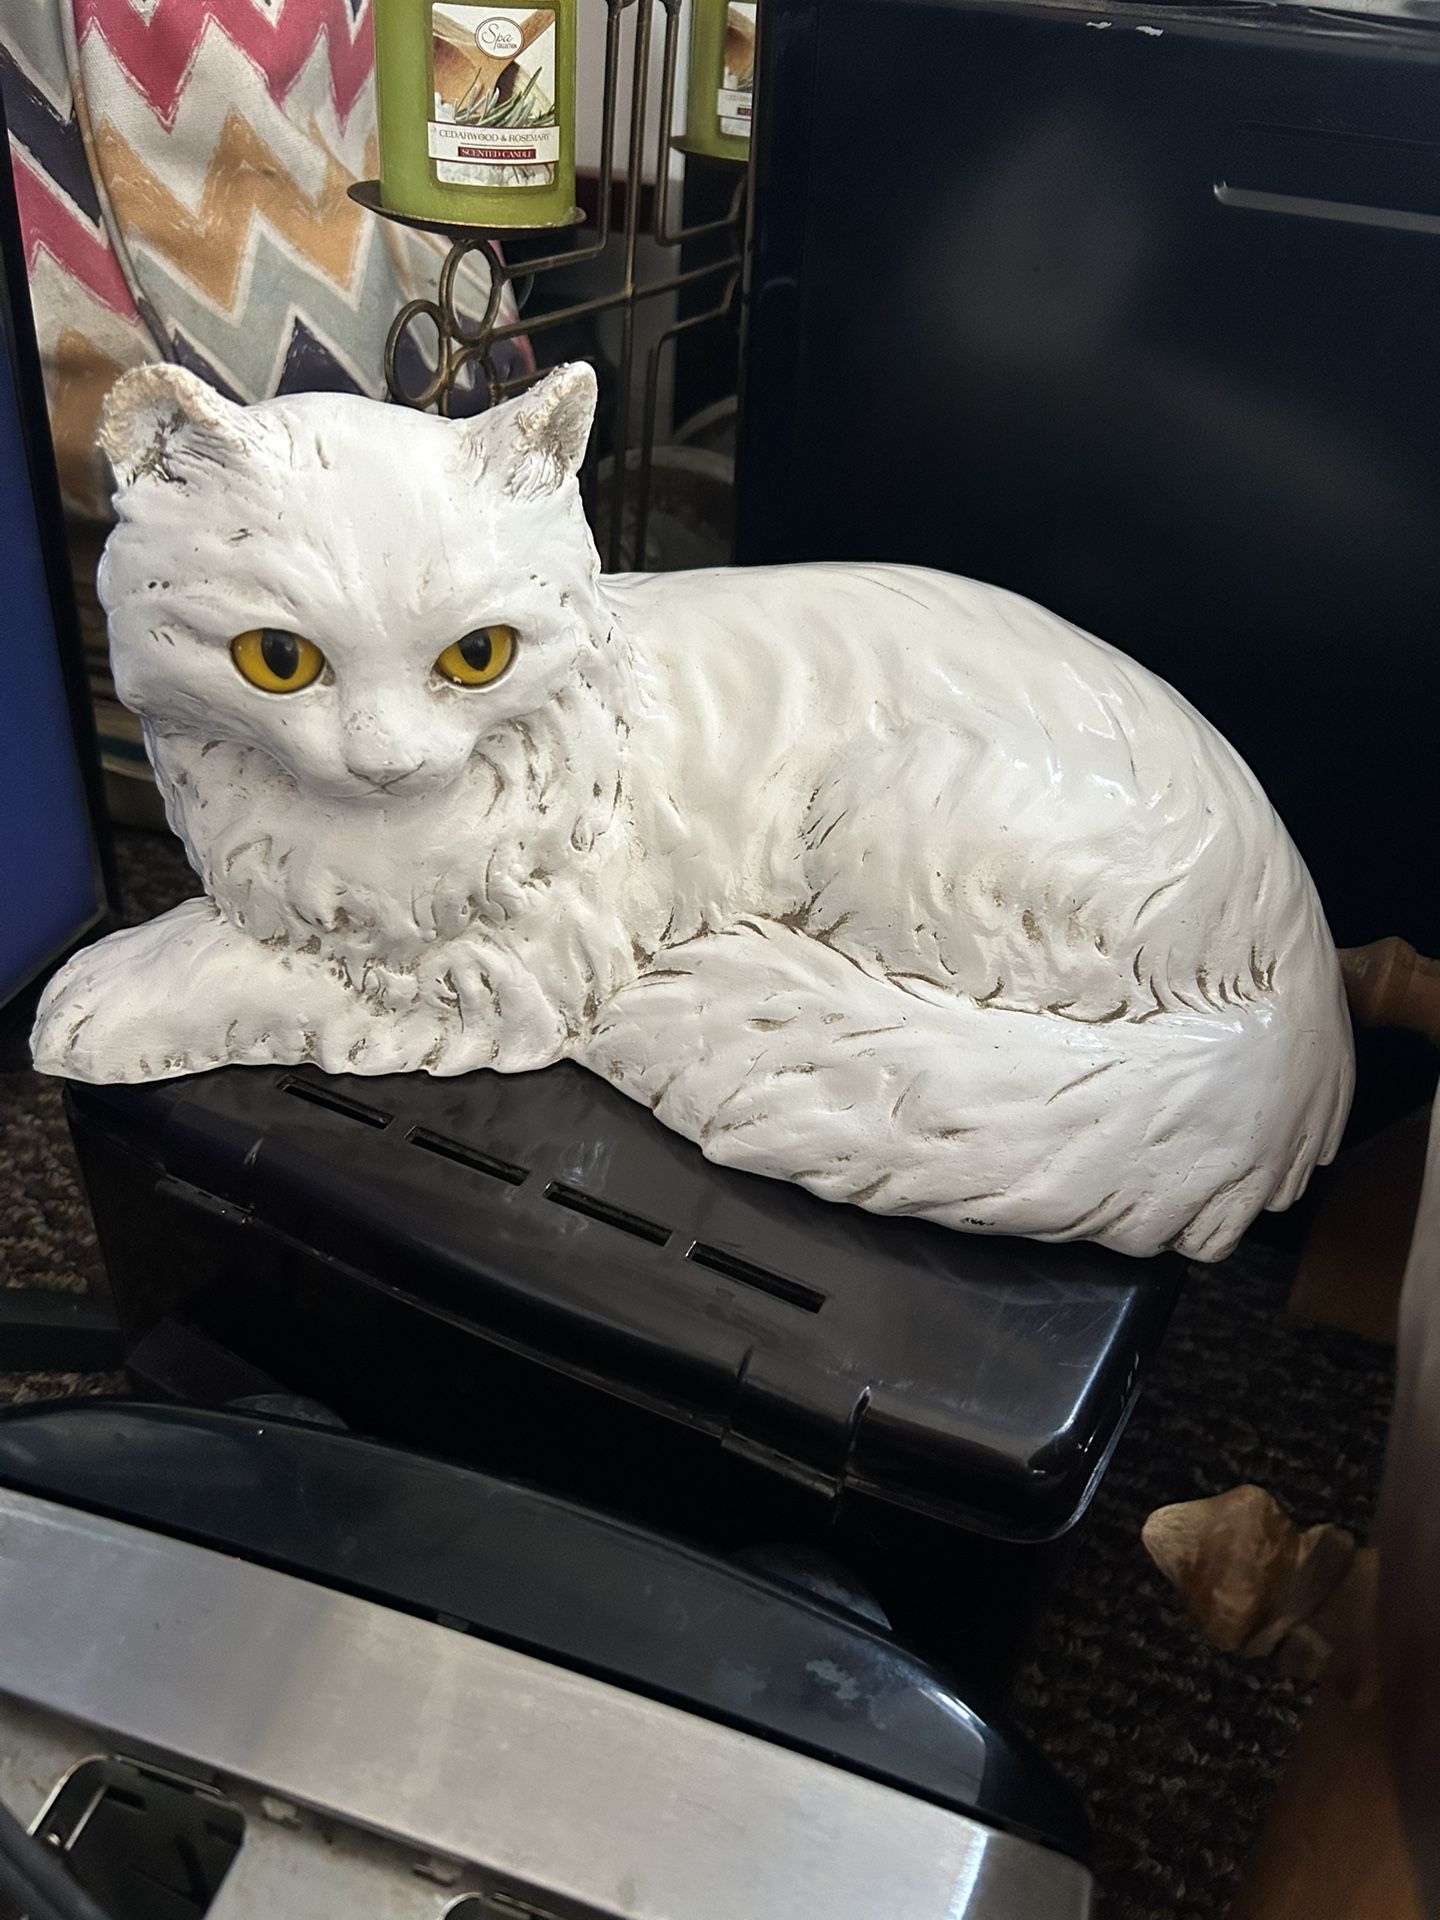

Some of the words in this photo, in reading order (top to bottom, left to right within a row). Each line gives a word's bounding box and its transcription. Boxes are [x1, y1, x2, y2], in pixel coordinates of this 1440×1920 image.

[481, 23, 513, 50] Spa
[439, 129, 499, 142] CEDARWOOD
[500, 134, 507, 142] &
[508, 134, 550, 143] ROSEMARY
[461, 148, 500, 158] SCENTED
[502, 150, 532, 159] CANDLE
